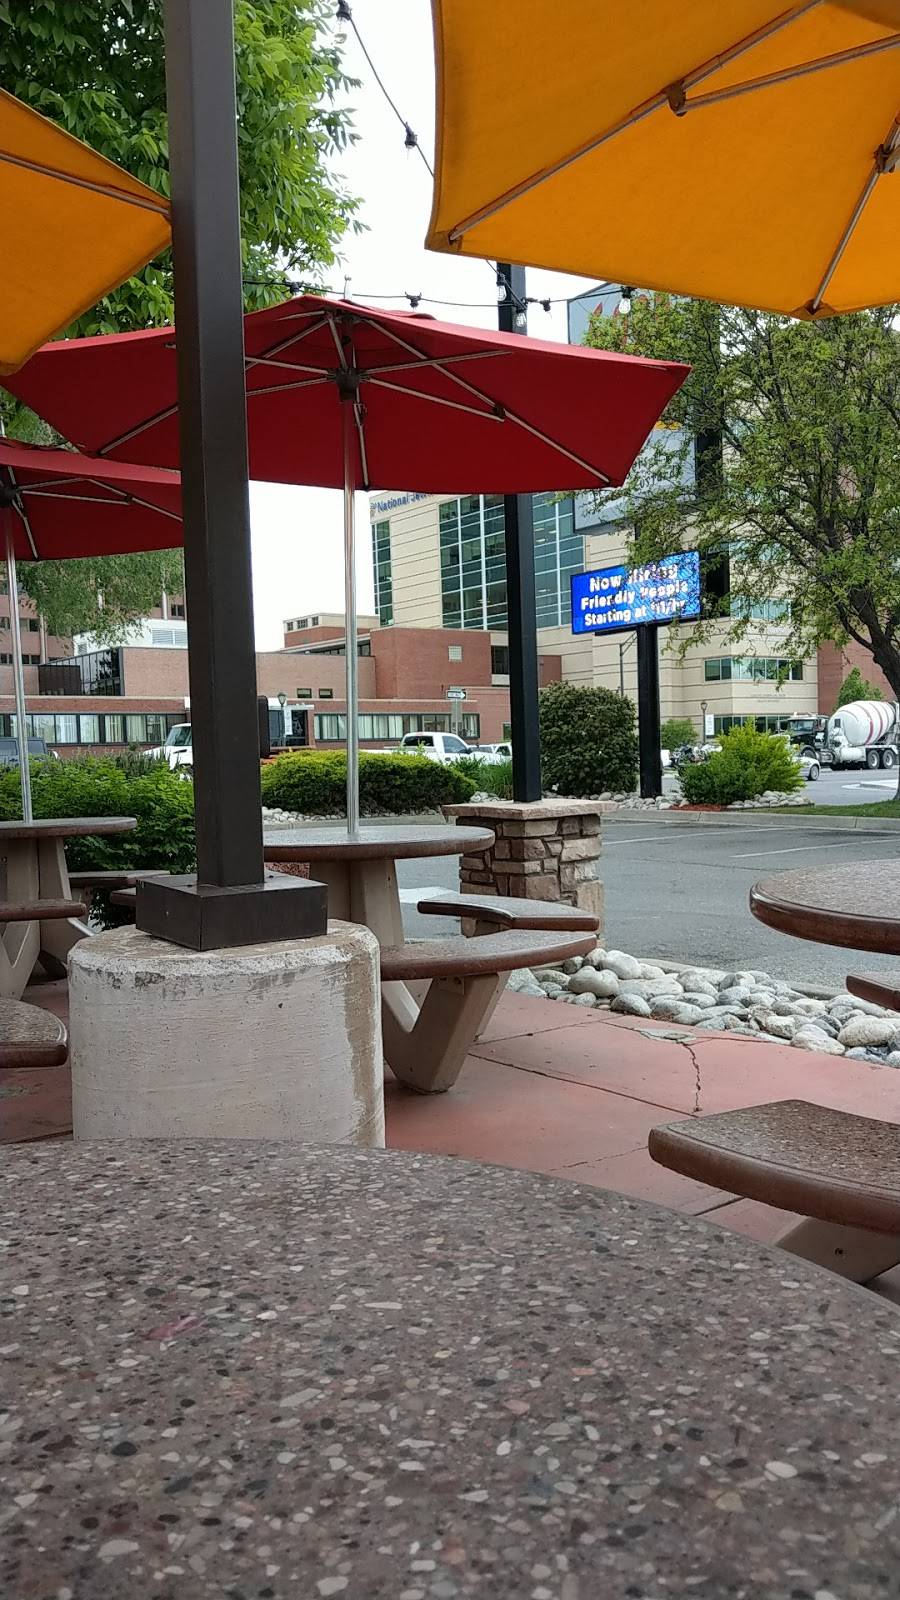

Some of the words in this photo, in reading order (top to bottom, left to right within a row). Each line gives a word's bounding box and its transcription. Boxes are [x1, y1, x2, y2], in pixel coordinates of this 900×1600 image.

[377, 493, 409, 512] National
[589, 575, 622, 593] Now
[584, 608, 632, 626] Starting
[634, 604, 647, 618] at
